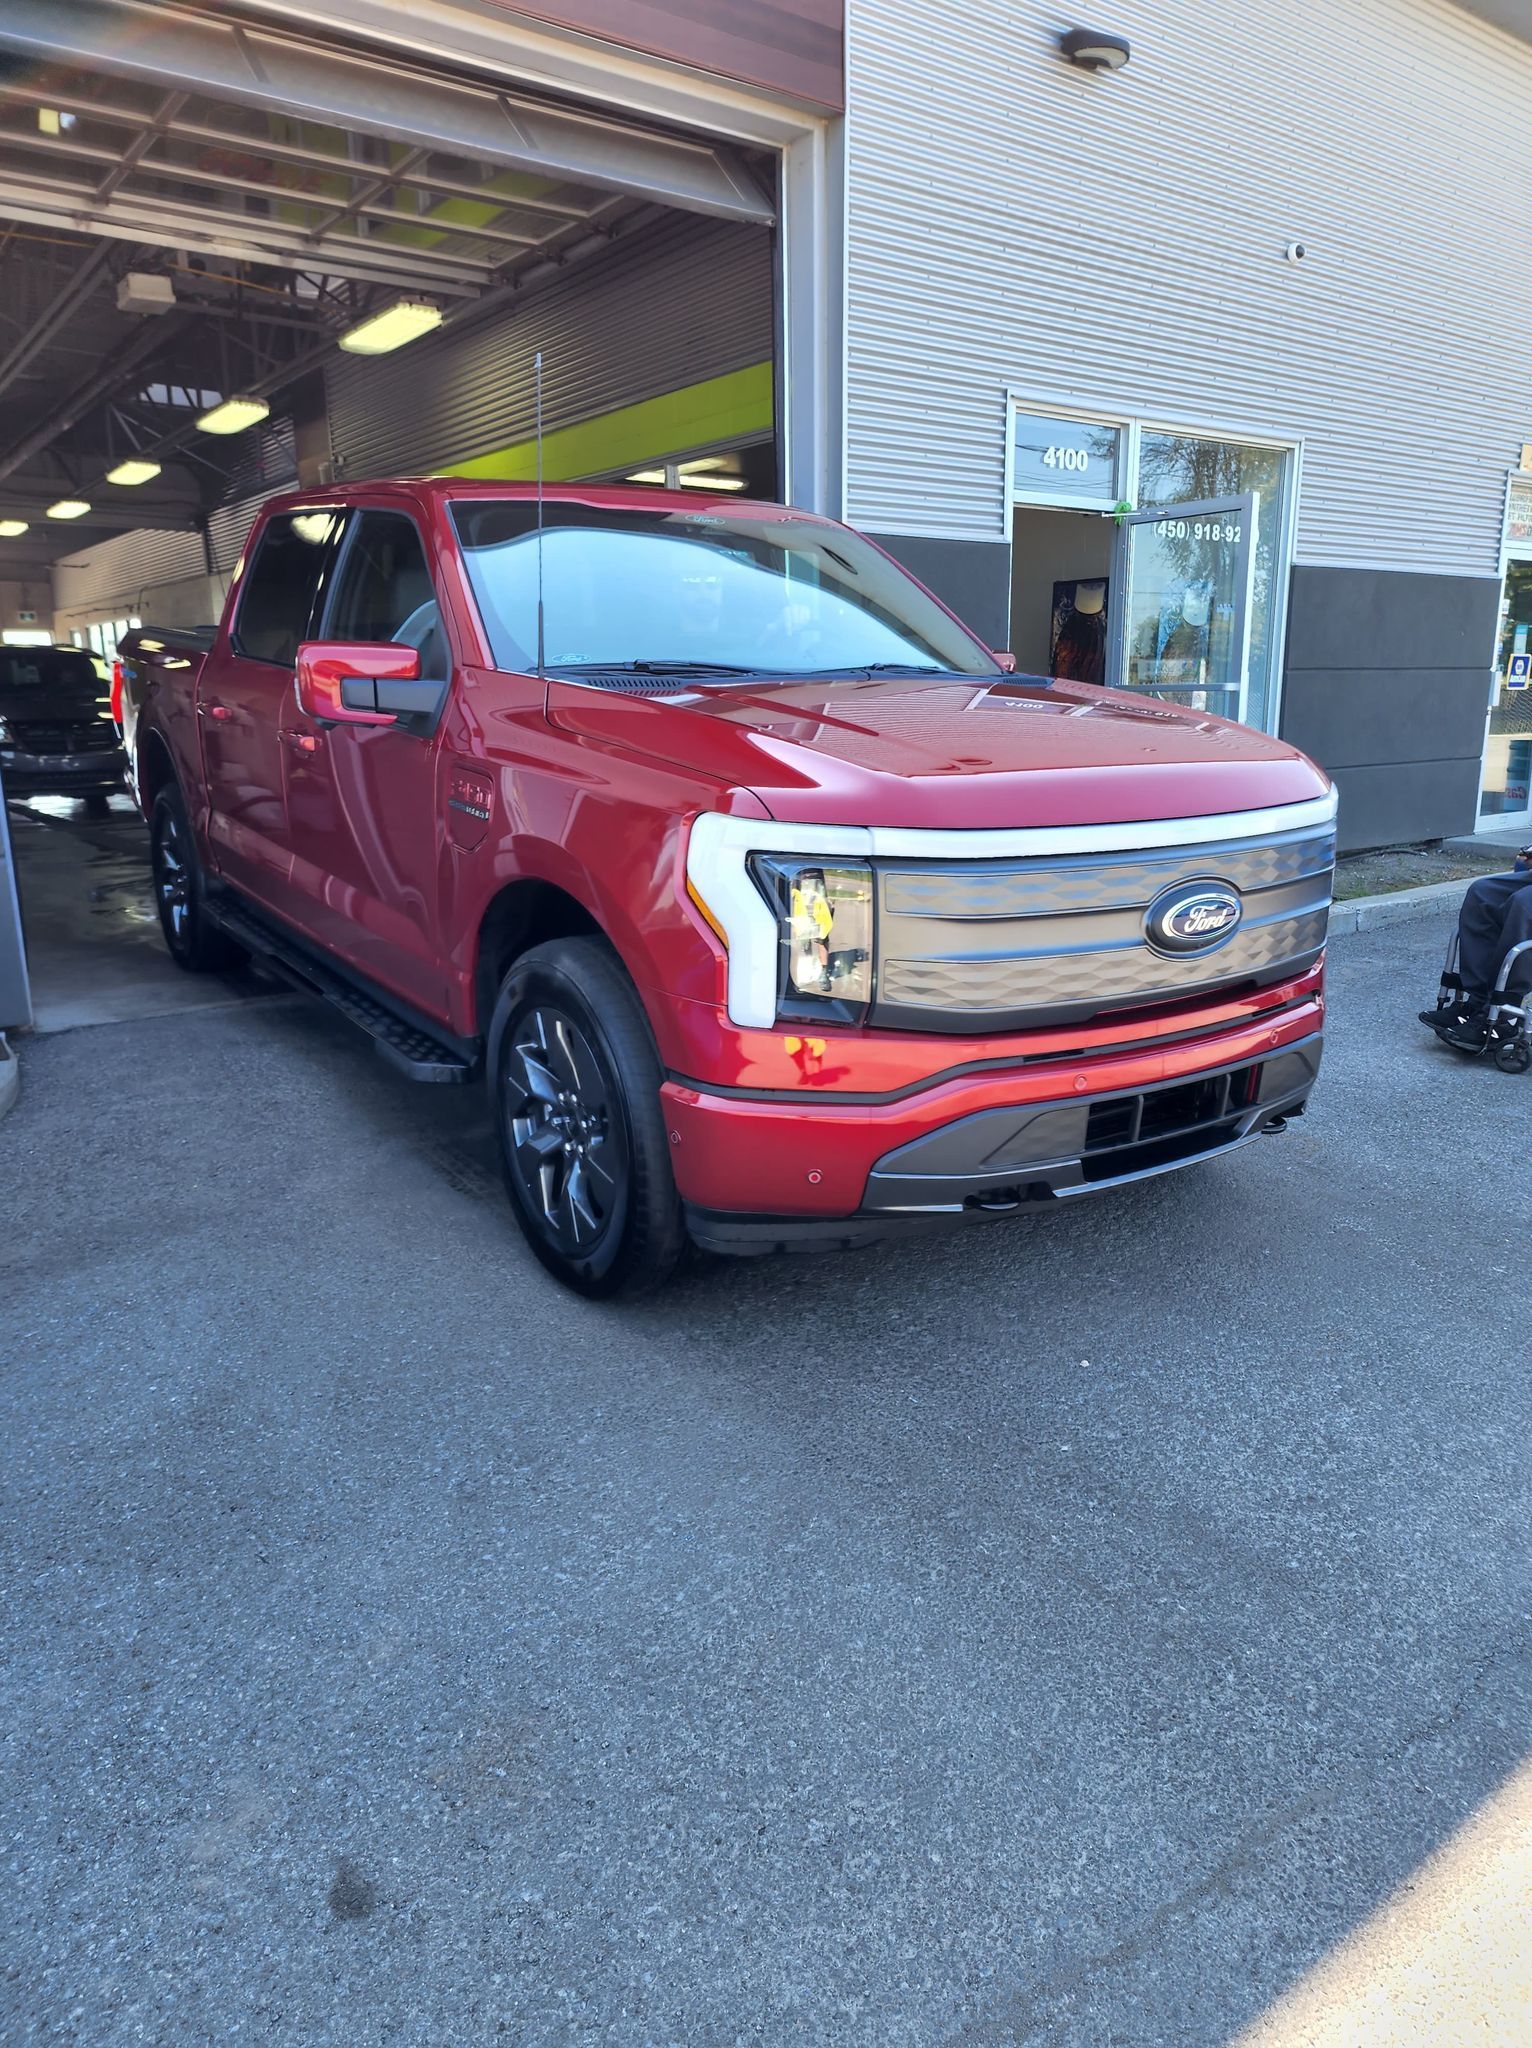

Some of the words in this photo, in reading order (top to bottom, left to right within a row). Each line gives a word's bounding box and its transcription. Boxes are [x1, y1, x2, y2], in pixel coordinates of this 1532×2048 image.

[1043, 446, 1088, 471] 4100
[1153, 520, 1190, 541] (450)
[1194, 523, 1241, 542] 918-92
[1184, 904, 1229, 933] Ford
